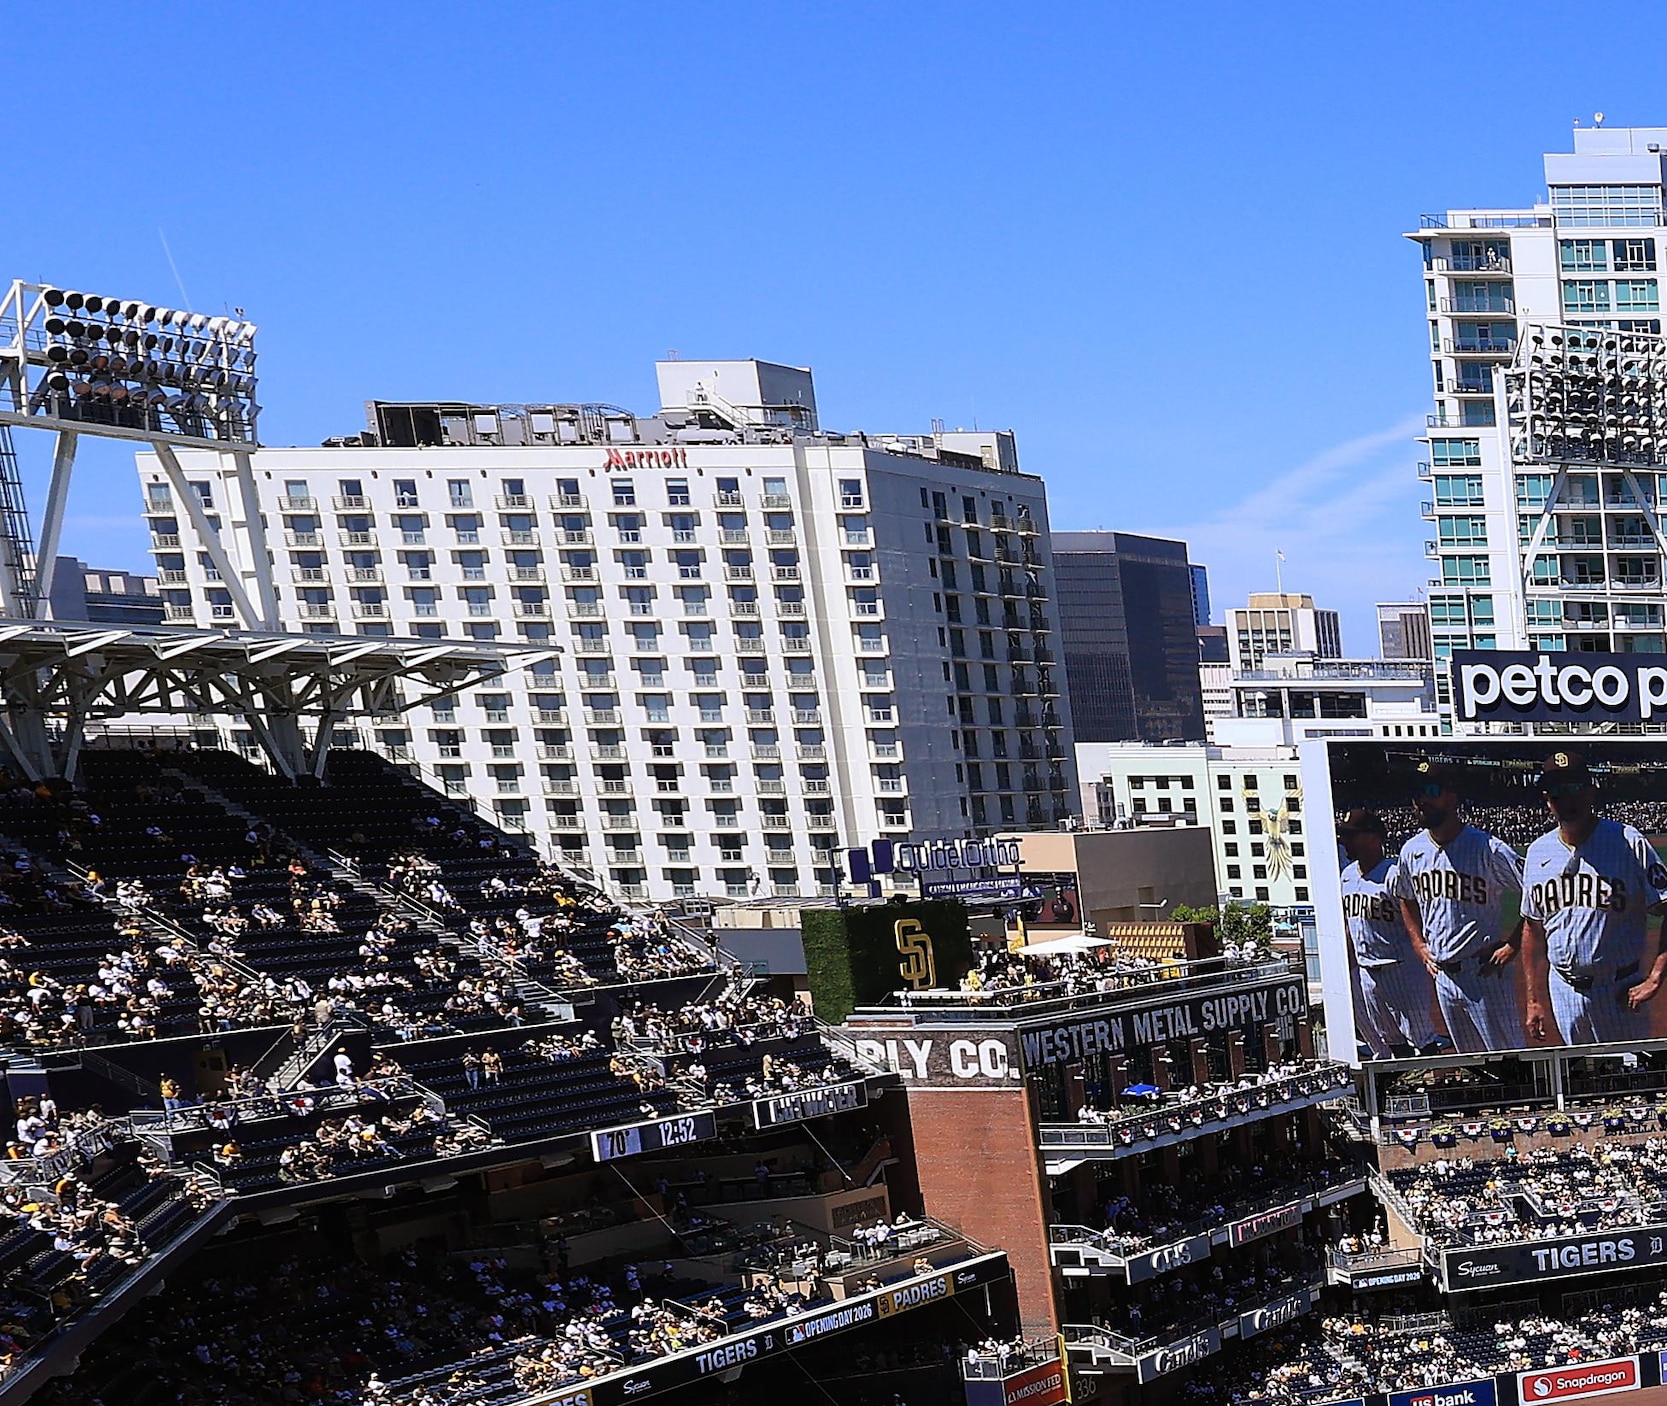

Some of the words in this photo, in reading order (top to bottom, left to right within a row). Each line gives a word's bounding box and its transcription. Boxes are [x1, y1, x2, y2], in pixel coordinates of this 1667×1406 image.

[603, 448, 687, 472] Marriott
[1461, 655, 1629, 719] petco
[1412, 871, 1487, 905] PADRES
[1531, 875, 1626, 913] PADRES
[1023, 1017, 1126, 1068] WESTERN
[1133, 1006, 1197, 1043] METAL
[1202, 993, 1268, 1030] SUPPLY
[1275, 985, 1305, 1017] CO.
[948, 1038, 1020, 1080] CO.
[659, 1118, 698, 1147] 12:52
[1458, 1261, 1499, 1278] Sycuan
[1532, 1238, 1636, 1273] TIGERS
[1405, 1271, 1421, 1282] 2026
[893, 1277, 947, 1311] PADRES
[805, 1317, 839, 1339] OPENING
[838, 1310, 854, 1328] DAY
[853, 1303, 873, 1322] 2026
[695, 1338, 759, 1374] TIGERS
[1017, 1382, 1046, 1400] MISSION
[1047, 1373, 1061, 1388] FED
[1556, 1369, 1627, 1391] Snapdragon
